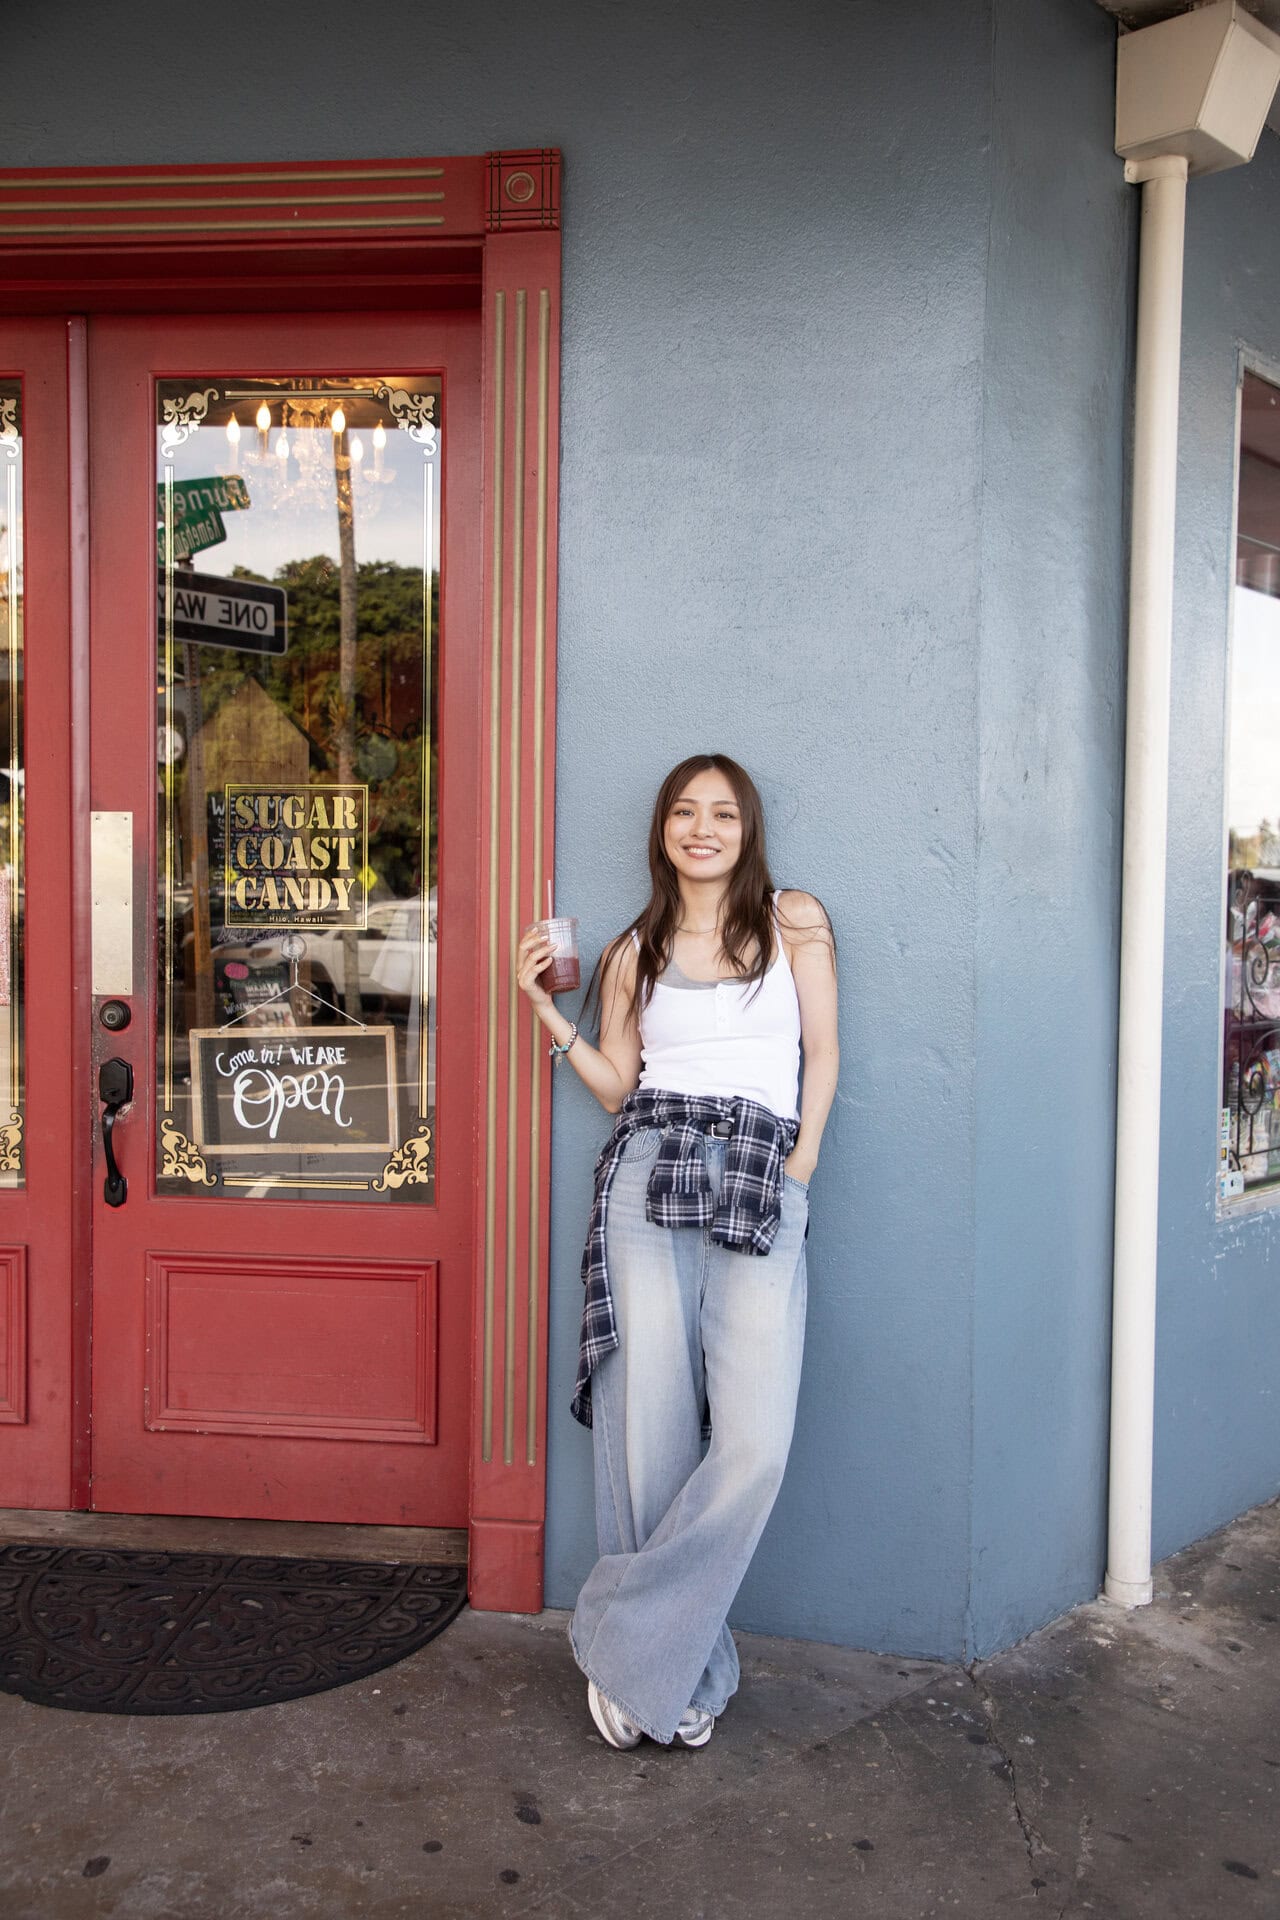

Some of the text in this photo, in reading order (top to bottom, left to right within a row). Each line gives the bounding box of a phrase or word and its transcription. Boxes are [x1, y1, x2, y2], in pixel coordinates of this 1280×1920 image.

[234, 796, 359, 830] SUGAR
[236, 836, 356, 871] COAST
[235, 877, 356, 911] CANDY
[215, 1044, 347, 1077] Come in! WE ARE
[232, 1068, 353, 1139] Open
